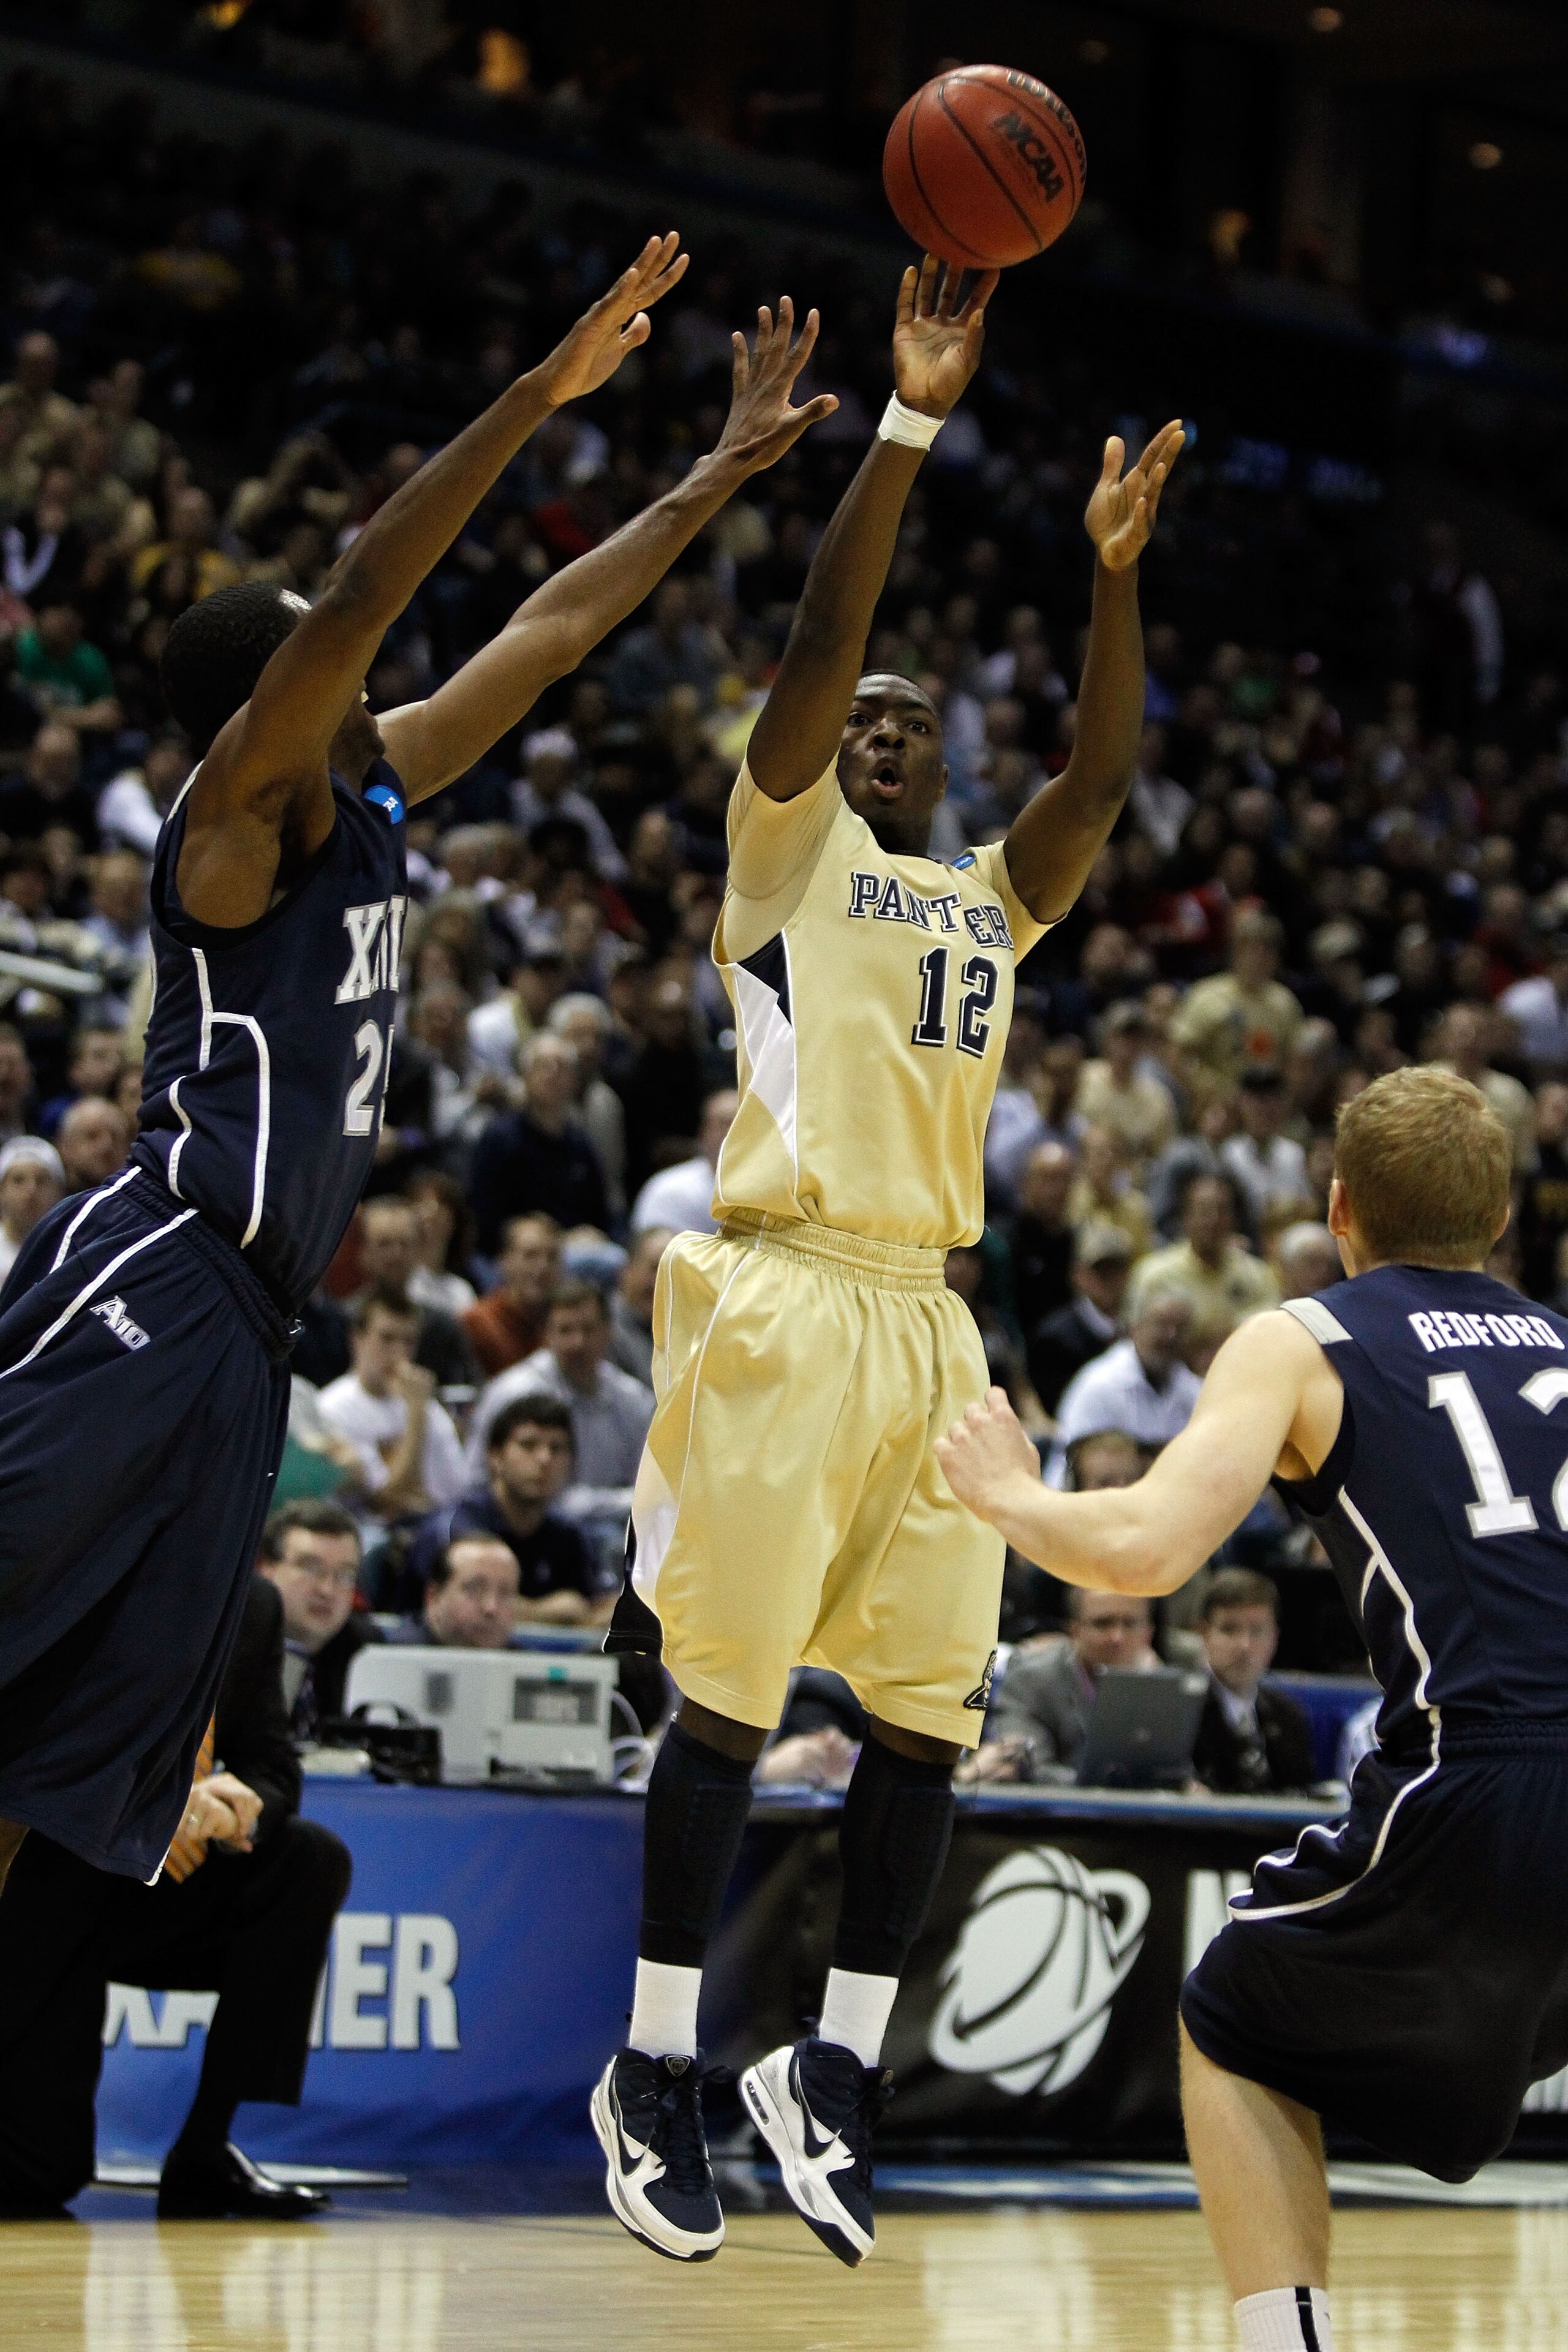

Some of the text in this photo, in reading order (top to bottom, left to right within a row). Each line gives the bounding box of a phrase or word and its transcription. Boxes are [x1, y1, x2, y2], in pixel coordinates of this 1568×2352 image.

[992, 113, 1065, 203] NCAA
[911, 945, 1000, 1059] 12
[342, 1018, 395, 1137] 2
[1408, 1310, 1566, 1353] REDFORD
[309, 1911, 461, 2050] ER
